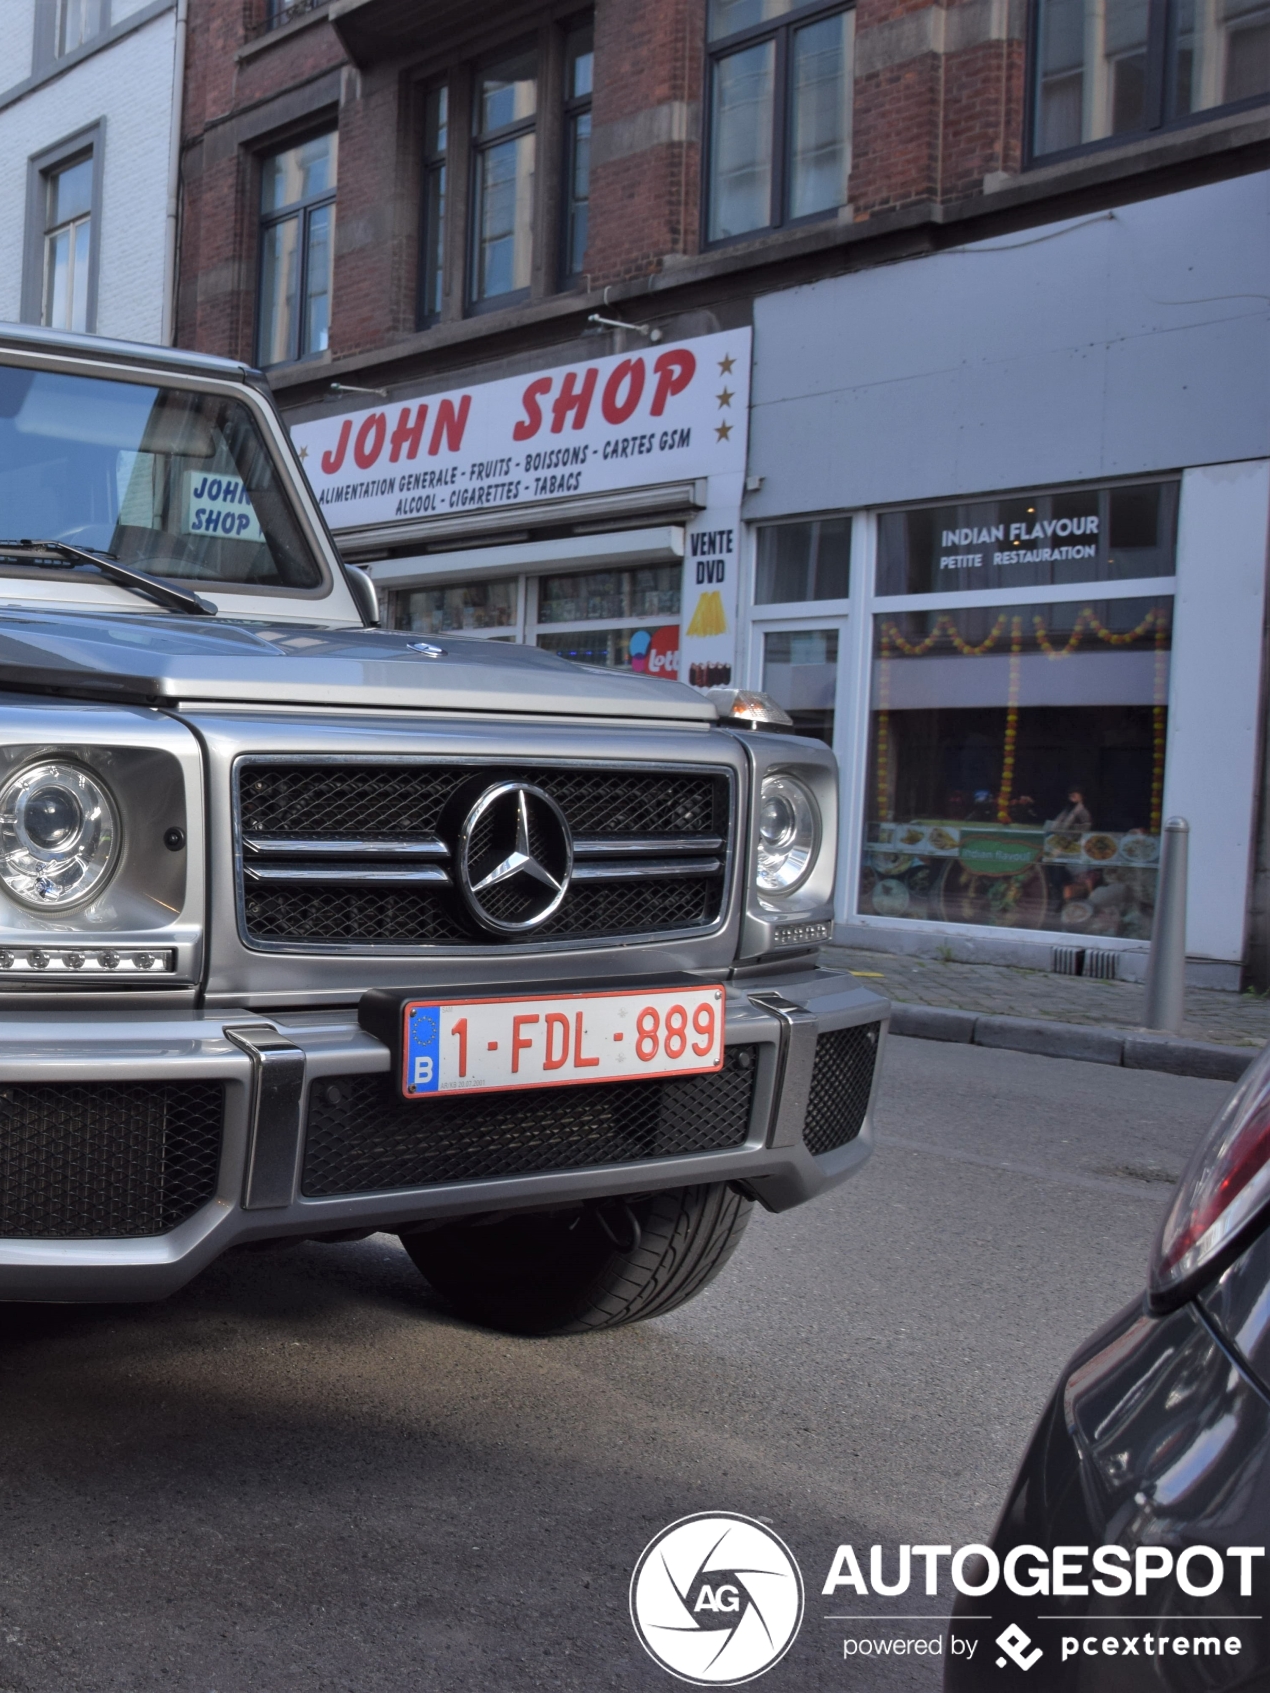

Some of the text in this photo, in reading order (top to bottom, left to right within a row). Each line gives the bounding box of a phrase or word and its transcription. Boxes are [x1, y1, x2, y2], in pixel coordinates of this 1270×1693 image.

[321, 348, 697, 475] JOHN SHOP
[318, 477, 396, 505] ALIMENTATION
[398, 466, 458, 493] GENERALE
[469, 457, 512, 482] FRUITS
[525, 444, 589, 473] BOISSONS
[602, 432, 656, 461] CARTES
[659, 427, 692, 451] GSM
[395, 493, 437, 516] ALCOOL
[449, 480, 521, 509] CIGARETTES
[534, 471, 583, 497] TABACS
[191, 508, 250, 536] SHOP
[941, 515, 1100, 547] INDIAN FLAVOUR
[690, 529, 733, 557] VENTE
[940, 544, 1096, 570] PETITE RESTAURATION
[695, 560, 726, 585] DVD
[414, 1056, 434, 1084] B
